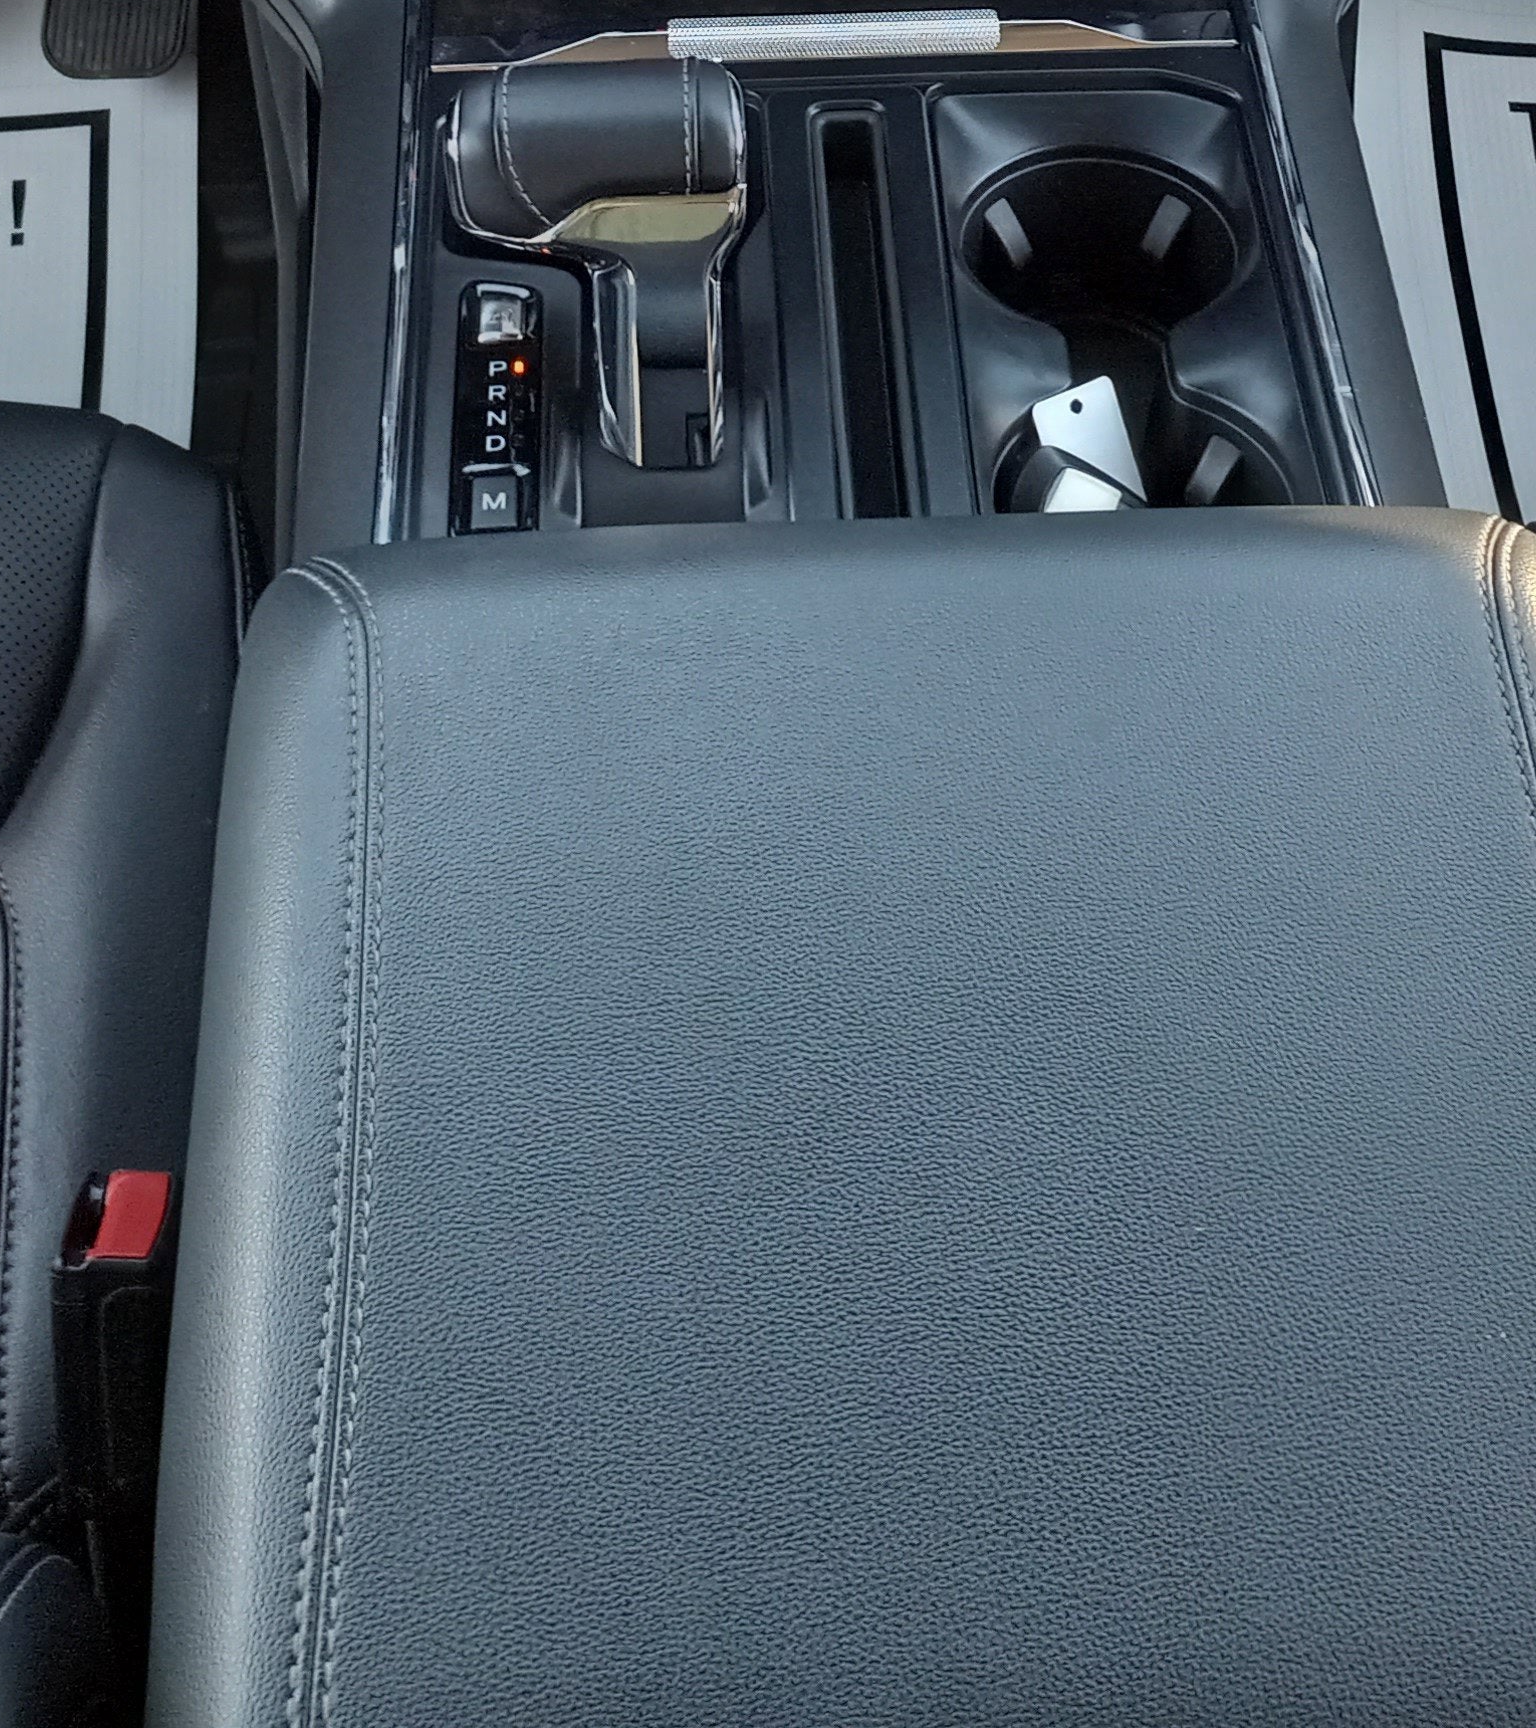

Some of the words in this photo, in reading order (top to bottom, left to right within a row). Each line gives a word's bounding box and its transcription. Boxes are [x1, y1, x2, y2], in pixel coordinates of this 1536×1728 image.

[489, 360, 507, 377] P
[488, 385, 506, 401] R
[486, 410, 506, 426] N
[485, 435, 505, 452] D
[482, 492, 506, 510] M
